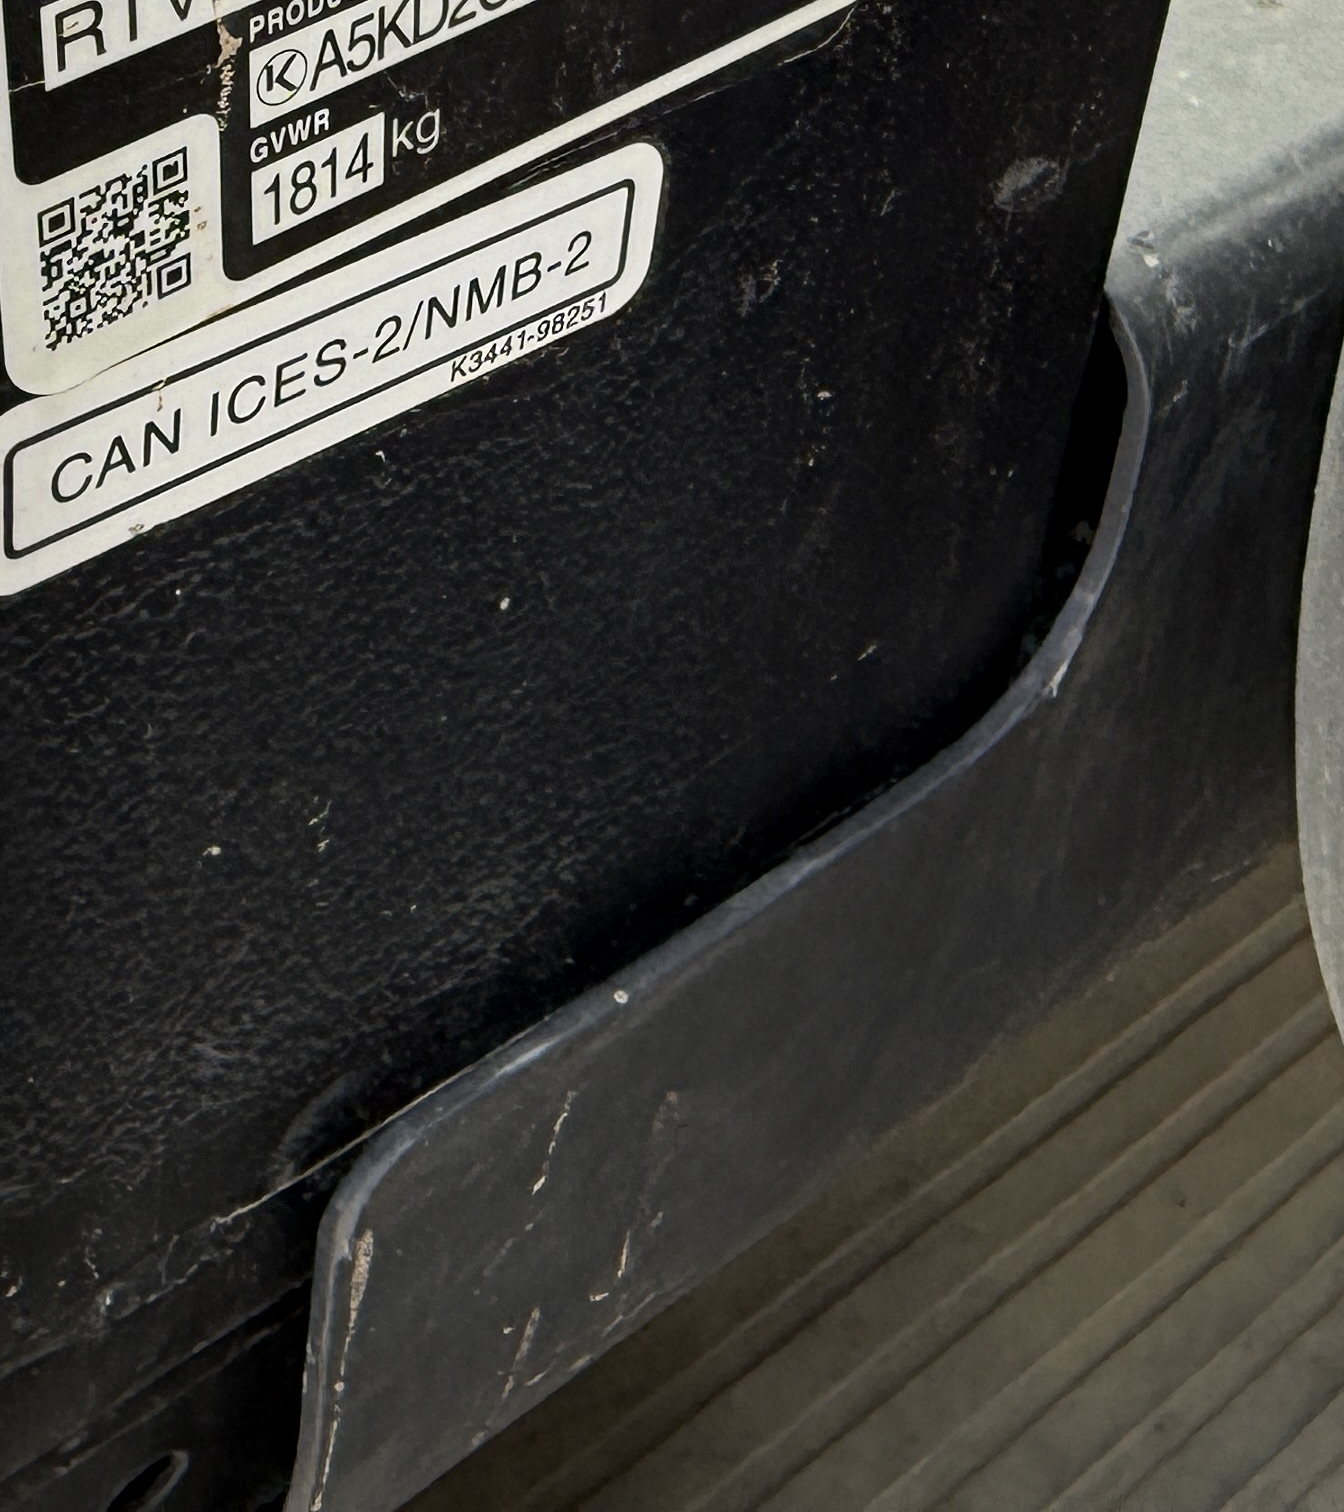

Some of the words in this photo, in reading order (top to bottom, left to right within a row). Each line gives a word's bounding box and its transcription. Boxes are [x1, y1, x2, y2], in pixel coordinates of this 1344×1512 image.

[251, 109, 329, 162] GVWR
[264, 133, 373, 225] 1814
[393, 109, 440, 157] kg
[51, 408, 181, 503] CAN
[211, 231, 591, 436] ICES-2/NMB-2
[448, 292, 606, 382] K3441-98251
